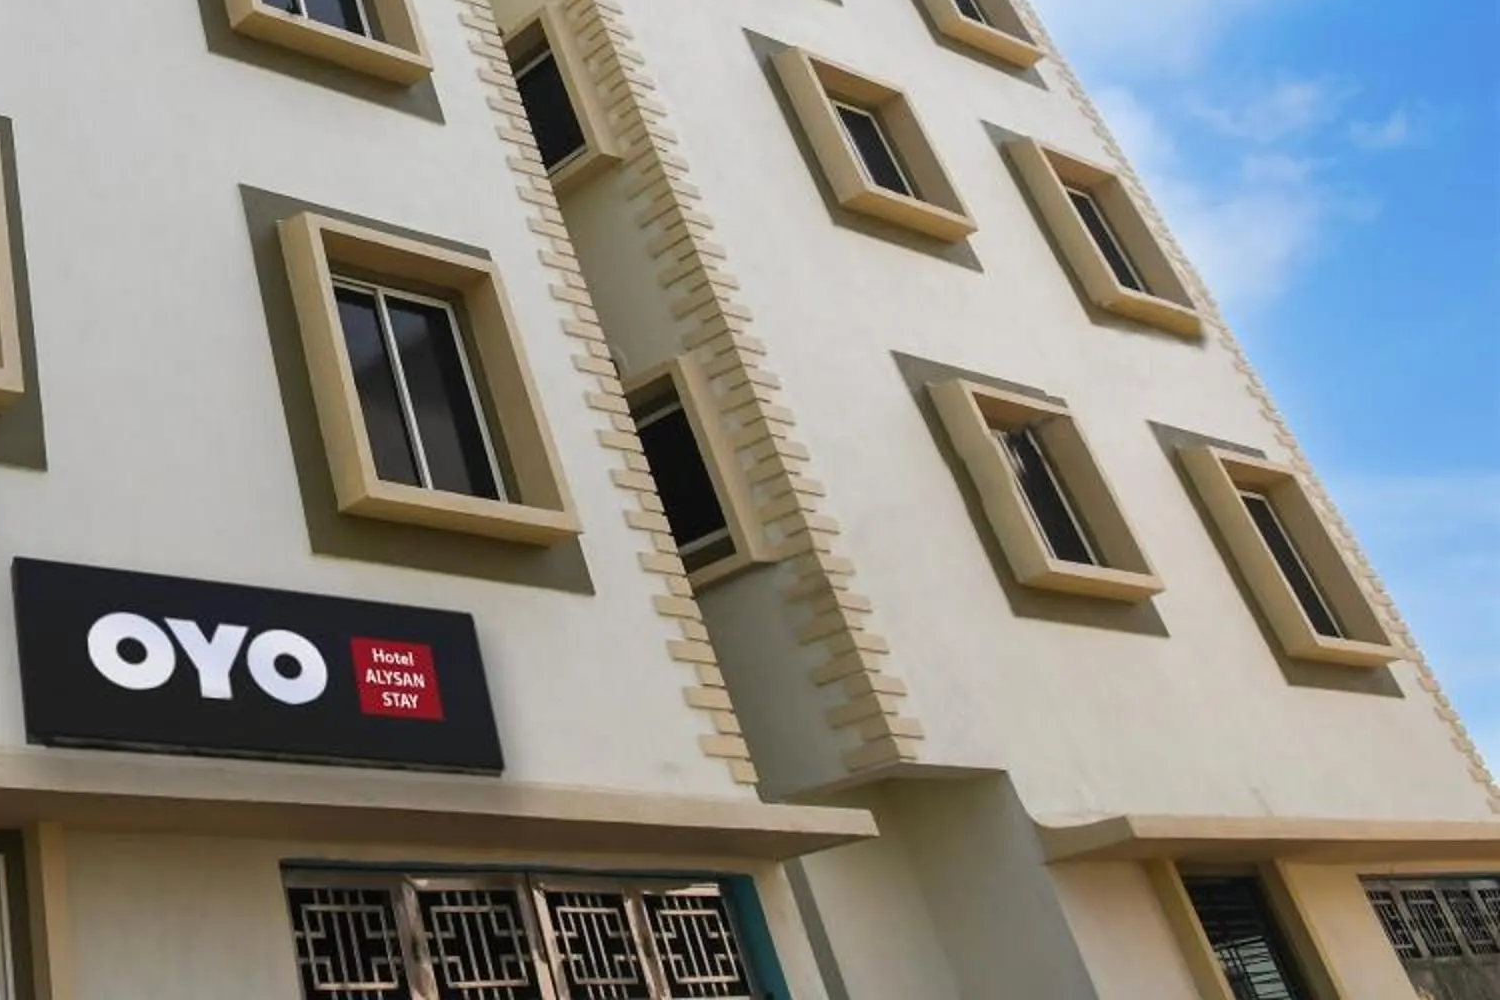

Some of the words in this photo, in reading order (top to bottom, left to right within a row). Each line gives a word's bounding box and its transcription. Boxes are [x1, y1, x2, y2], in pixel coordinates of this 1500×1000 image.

[87, 612, 328, 705] OYO
[371, 647, 415, 667] Hotel
[365, 668, 426, 688] ALYSAN
[381, 691, 419, 709] STAY
